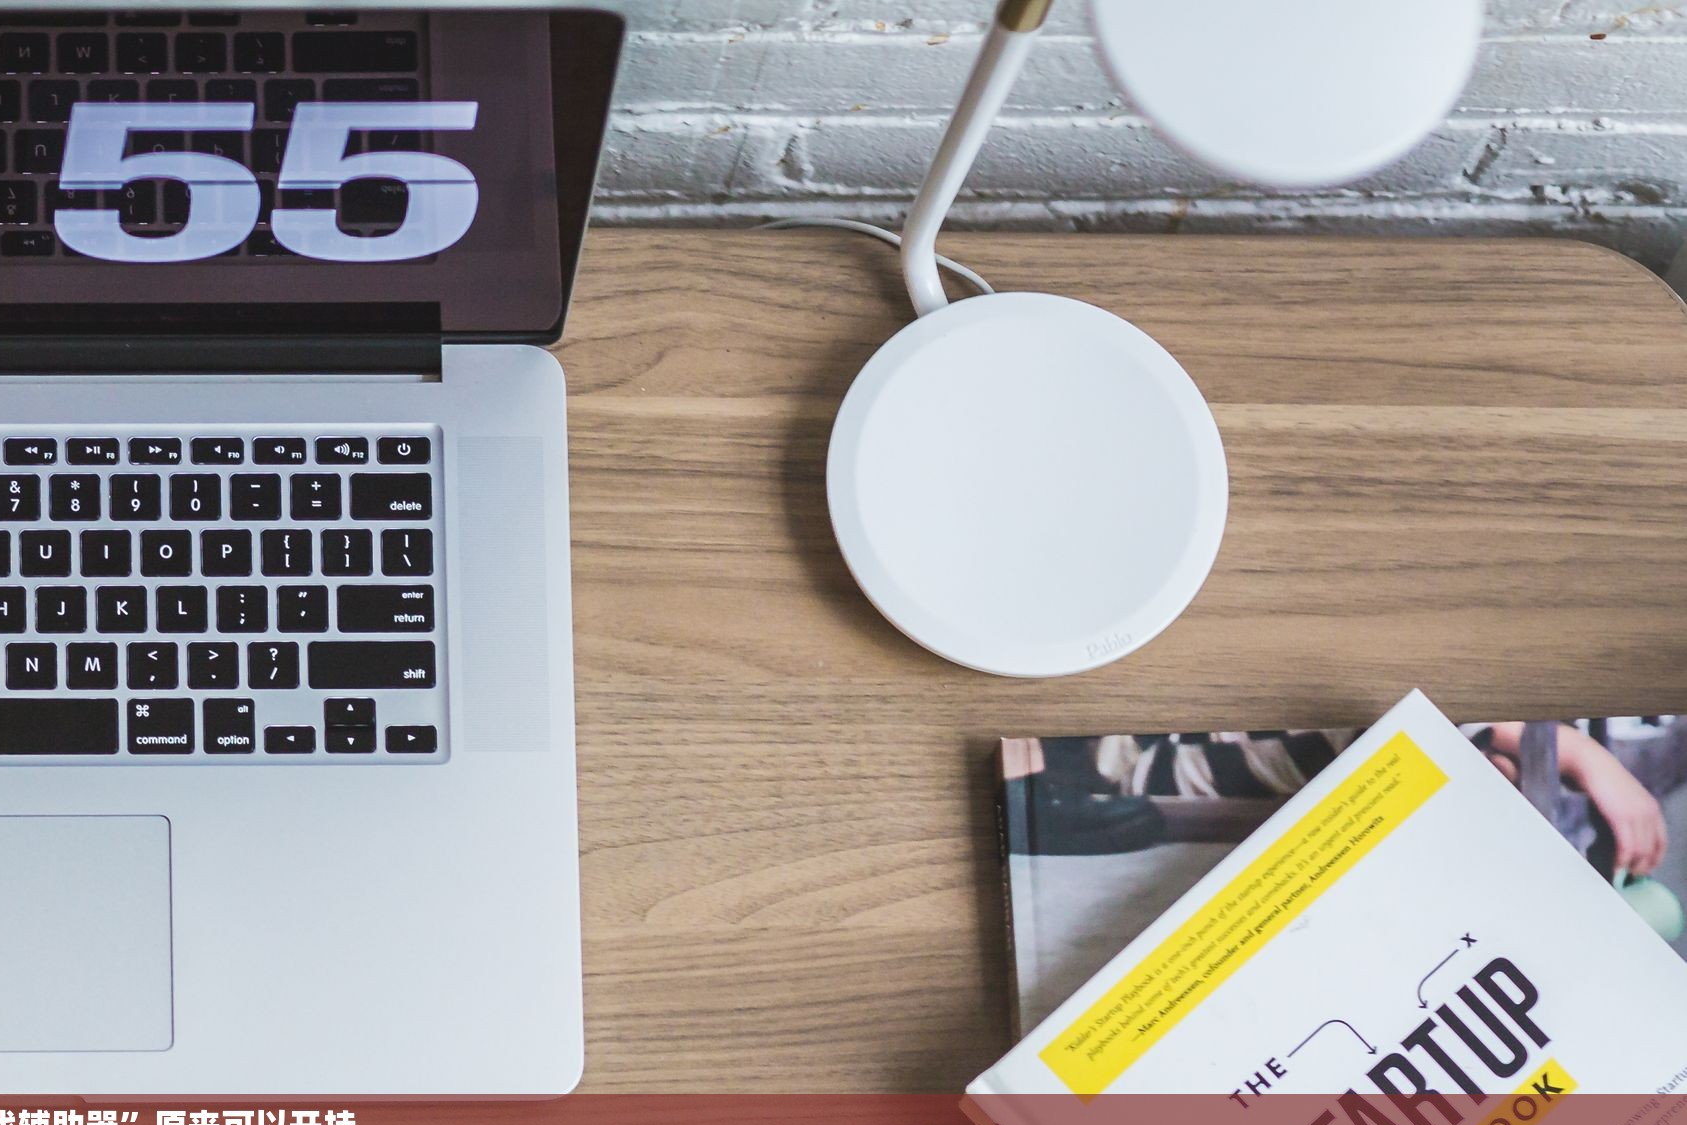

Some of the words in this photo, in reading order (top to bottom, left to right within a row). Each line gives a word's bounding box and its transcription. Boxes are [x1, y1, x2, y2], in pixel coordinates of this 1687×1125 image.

[53, 101, 480, 263] 55
[43, 452, 53, 460] F7
[106, 452, 116, 460] F8
[227, 451, 240, 459] F10
[352, 451, 365, 459] F12
[10, 498, 20, 512] 7
[70, 498, 81, 512] 8
[130, 498, 141, 512] 9
[190, 497, 201, 512] 0
[389, 500, 422, 511] delete
[39, 544, 53, 560] U
[104, 544, 109, 560] I
[159, 544, 173, 559] O
[221, 543, 233, 559] P
[401, 591, 424, 599] enter
[56, 601, 66, 616] J
[116, 600, 129, 616] K
[177, 600, 188, 615] L
[393, 613, 425, 623] return
[25, 657, 39, 673] N
[84, 656, 101, 672] M
[403, 668, 426, 679] shift
[237, 704, 249, 714] alt
[136, 733, 188, 745] command
[217, 735, 250, 747] option
[1229, 1057, 1288, 1109] THE
